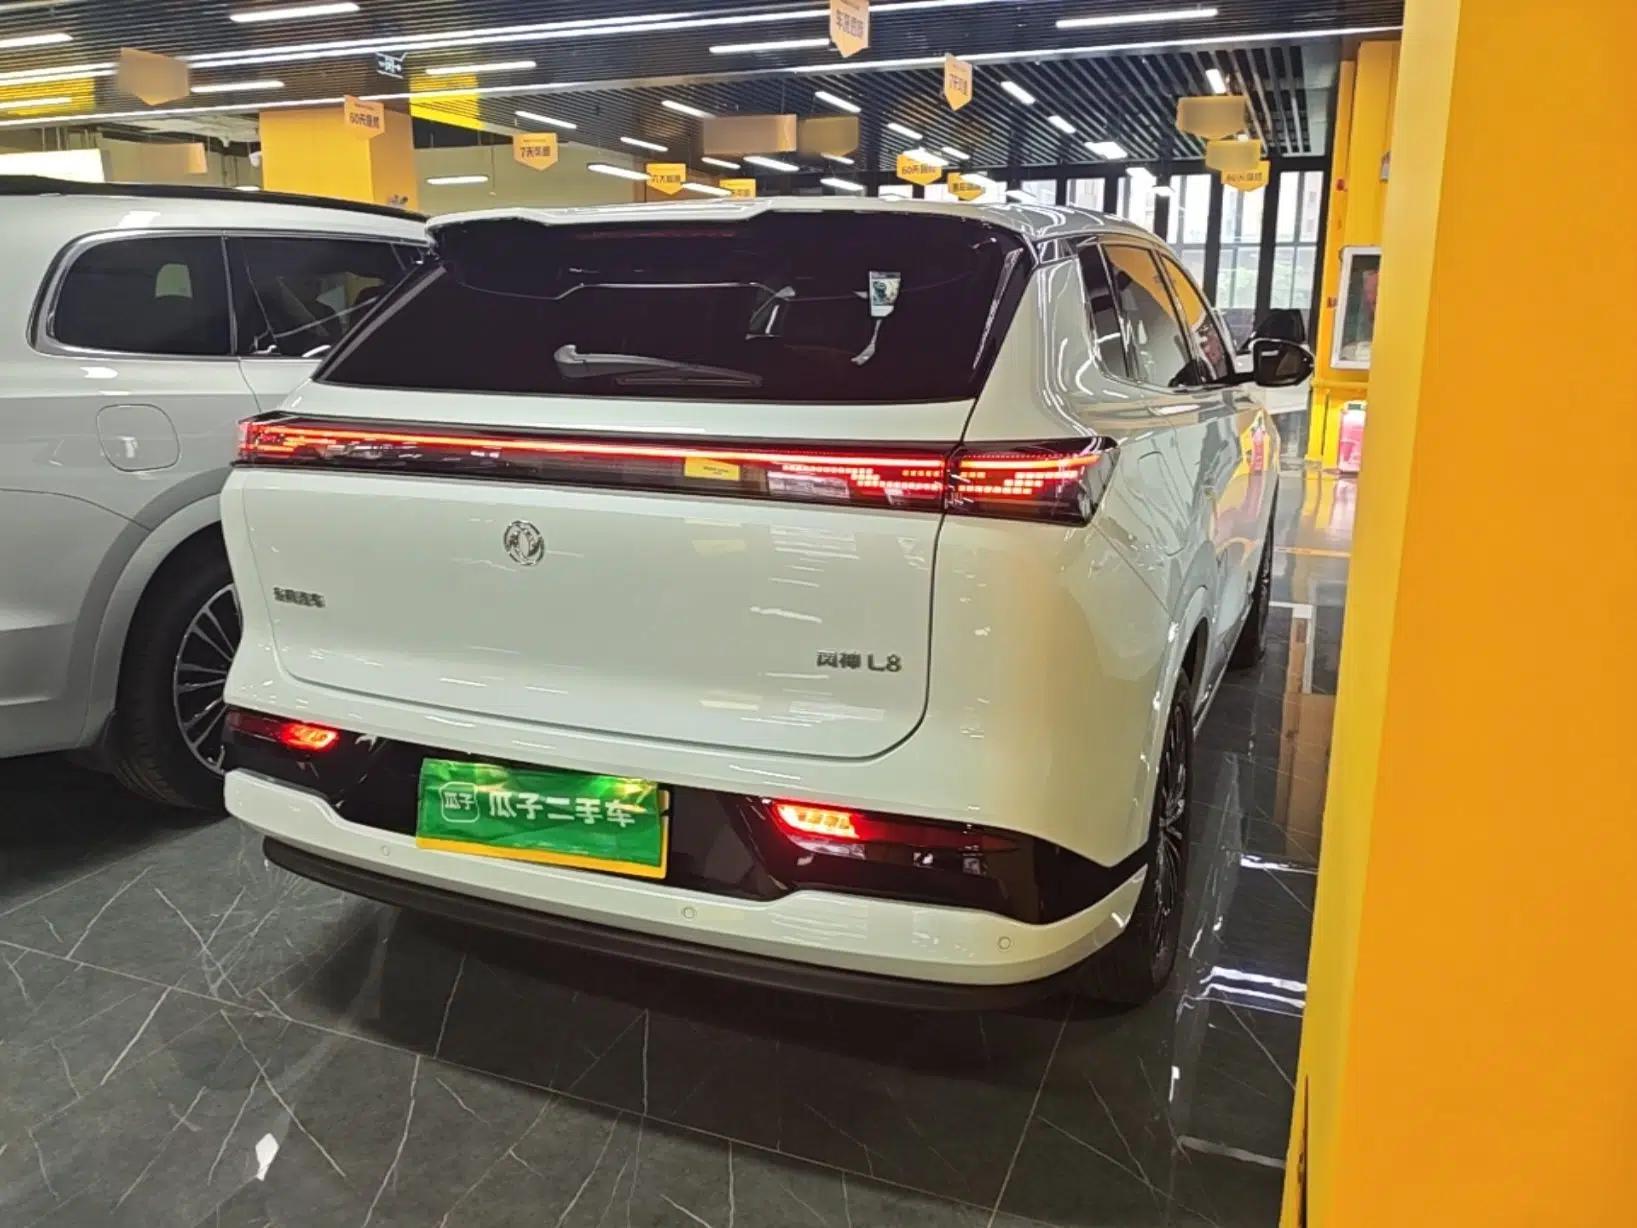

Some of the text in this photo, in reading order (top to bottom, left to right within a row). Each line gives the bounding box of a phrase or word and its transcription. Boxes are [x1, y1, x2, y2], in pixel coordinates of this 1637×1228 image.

[816, 651, 902, 672] 风神 L8
[444, 791, 475, 810] 瓜子
[489, 790, 636, 828] 瓜子二手车
